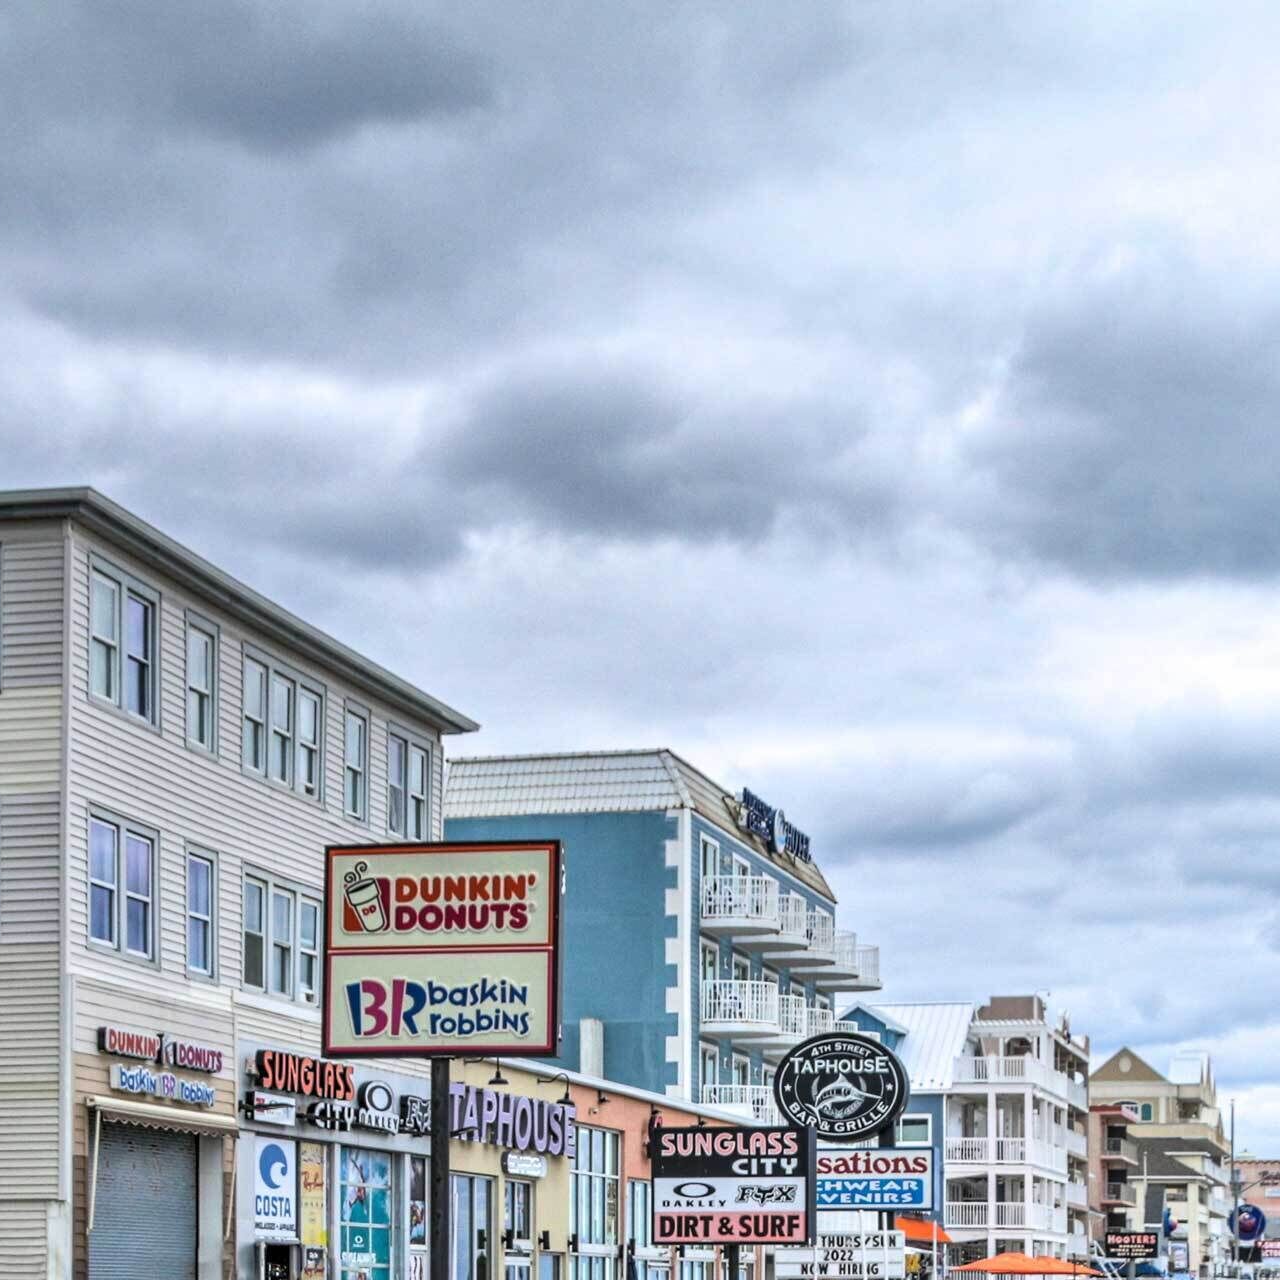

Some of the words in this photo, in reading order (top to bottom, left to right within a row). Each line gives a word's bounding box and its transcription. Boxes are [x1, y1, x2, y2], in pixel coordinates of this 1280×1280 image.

[395, 874, 536, 903] DUNKIN'
[362, 904, 377, 916] DD
[395, 903, 528, 931] DONUTS
[179, 1043, 223, 1072] DONUTS
[811, 1044, 831, 1057] 4TH
[835, 1042, 872, 1057] STREET
[262, 1050, 355, 1101] SUNGLASS
[790, 1056, 890, 1074] TAPHOUSE
[314, 1101, 355, 1132] CITY
[449, 1082, 577, 1159] TAPHOUSE
[789, 1101, 818, 1128] BAR
[820, 1120, 830, 1131] &
[834, 1100, 889, 1132] GRILLE
[661, 1132, 798, 1157] SUNGLASS
[731, 1158, 798, 1175] CITY
[255, 1195, 291, 1218] COSTA
[662, 1200, 726, 1208] OAKLEY
[816, 1193, 913, 1204] VENIRS
[659, 1215, 714, 1238] DIRT
[718, 1216, 734, 1235] &
[739, 1215, 800, 1238] SURF
[1107, 1234, 1157, 1245] HOOTERS
[824, 1249, 853, 1261] 2022
[839, 1263, 879, 1275] HIRIG
